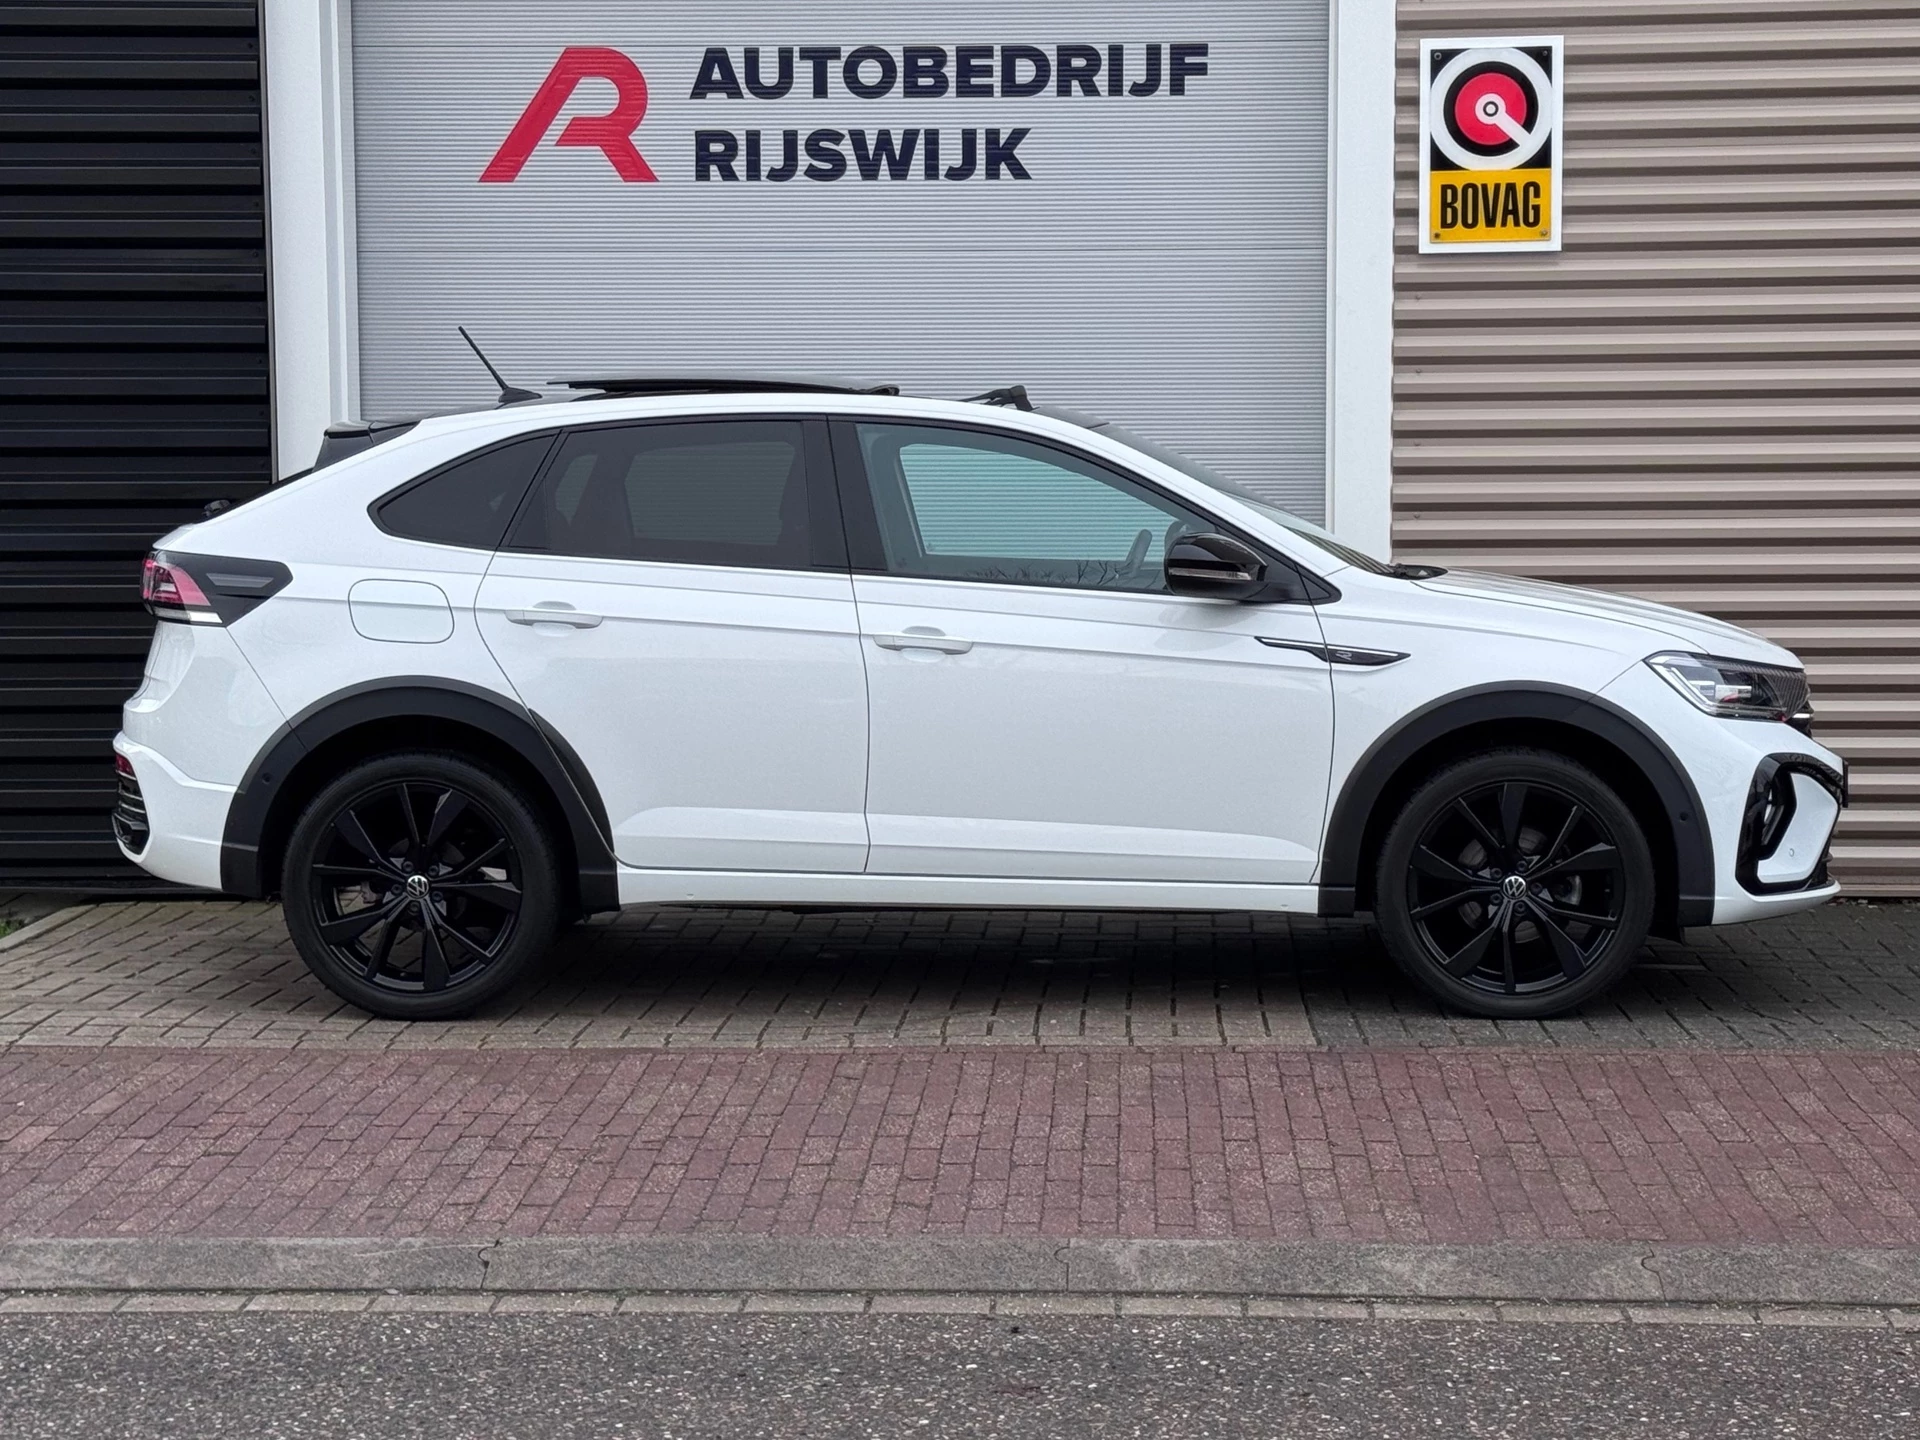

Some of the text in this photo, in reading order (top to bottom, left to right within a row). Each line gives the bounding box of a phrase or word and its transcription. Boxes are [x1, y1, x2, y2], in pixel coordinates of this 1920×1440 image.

[689, 43, 1209, 100] AUTOBEDRIJF
[694, 128, 1033, 182] RIJSWIJK
[1440, 181, 1541, 229] BOVAG
